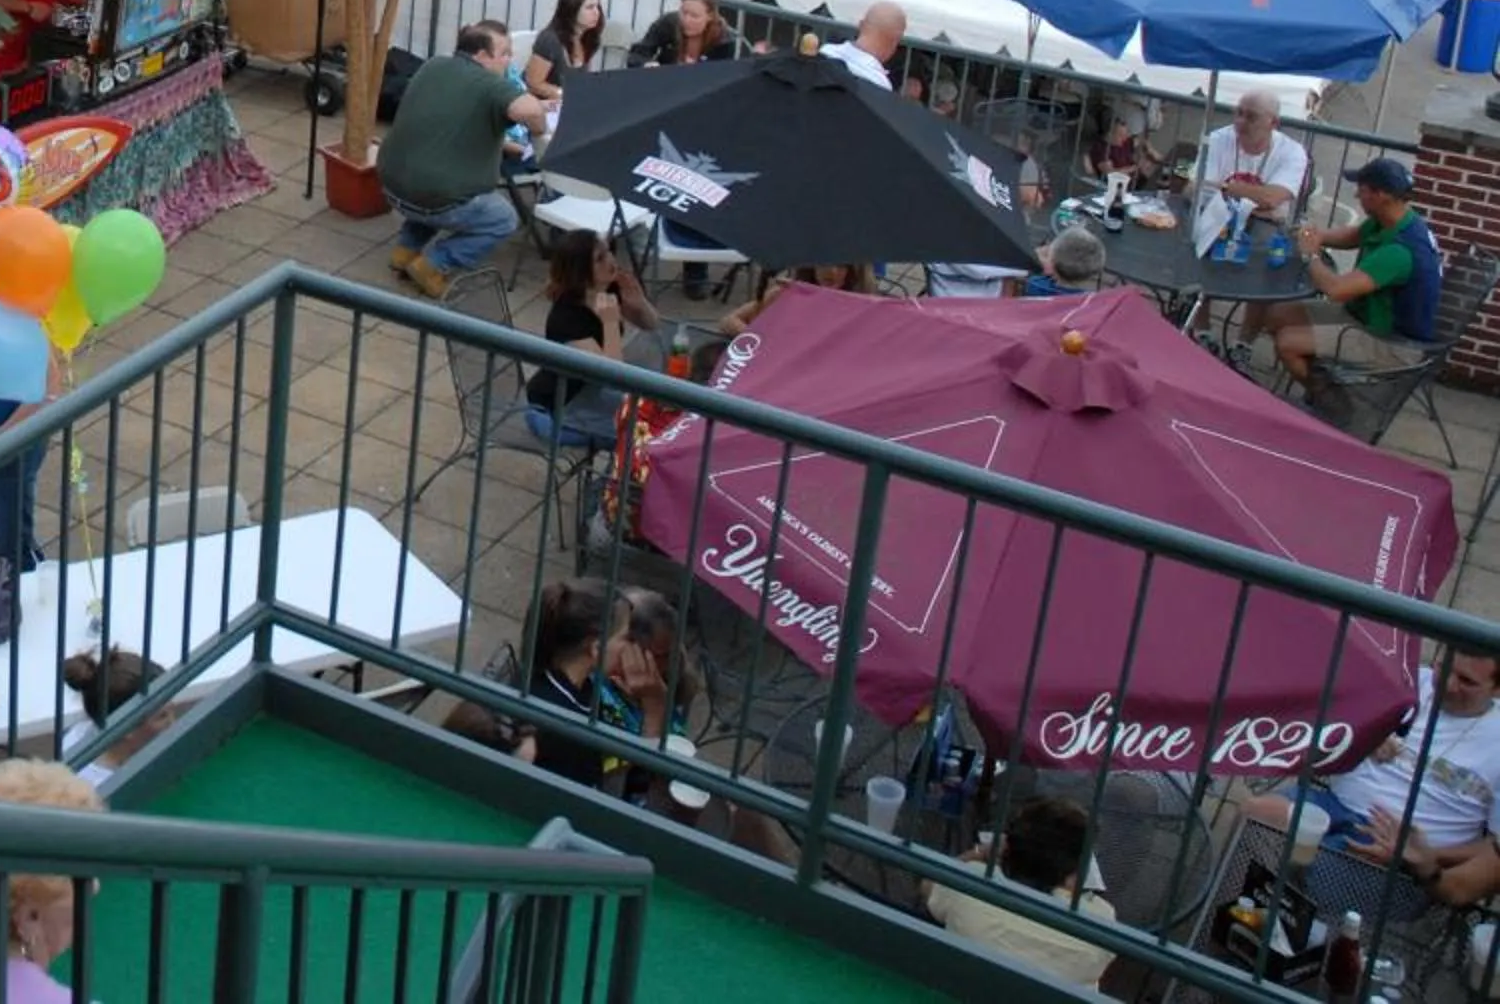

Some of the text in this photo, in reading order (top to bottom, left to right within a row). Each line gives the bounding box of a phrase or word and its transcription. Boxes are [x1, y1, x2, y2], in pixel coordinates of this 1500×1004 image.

[634, 177, 699, 213] ICE
[702, 523, 879, 664] Yuenglin
[1041, 692, 1354, 768] Since 1829
